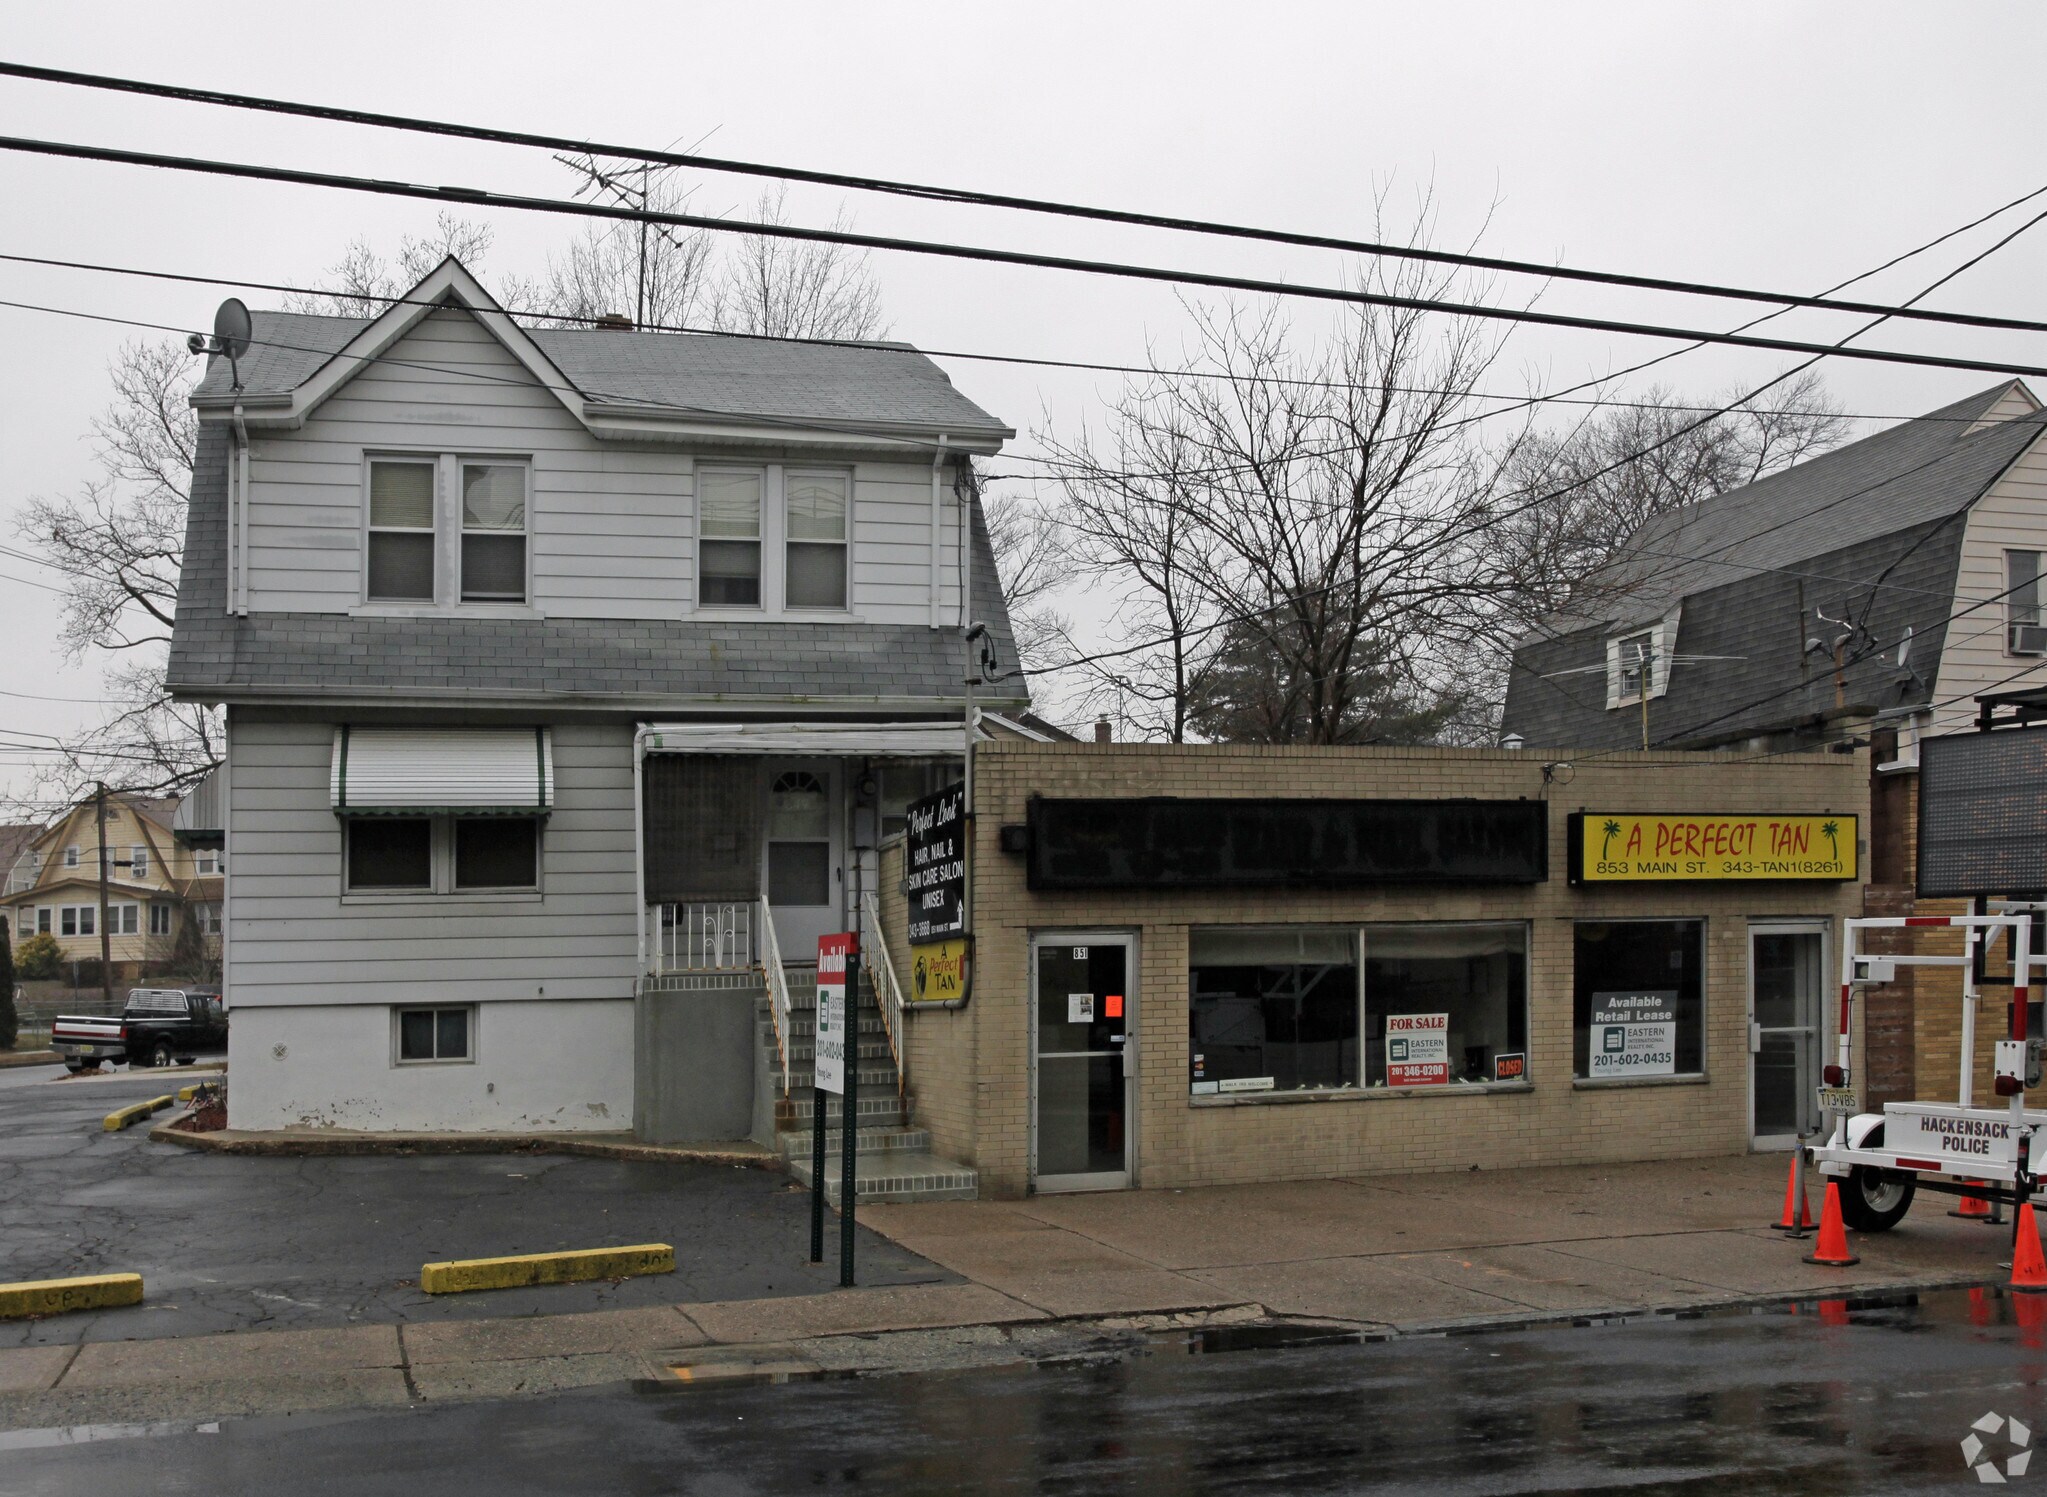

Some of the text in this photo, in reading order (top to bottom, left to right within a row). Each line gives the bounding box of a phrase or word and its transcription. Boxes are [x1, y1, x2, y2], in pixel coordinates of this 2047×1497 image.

[1626, 822, 1810, 858] A PERFECT TAN
[931, 842, 946, 860] NAIL
[948, 838, 954, 856] &
[909, 861, 964, 890] SKIN CARE SALON
[1596, 861, 1843, 874] 853 MAIN ST. 343-TAN1(8261)
[922, 889, 944, 909] UNISEX
[818, 945, 847, 973] Availabl
[941, 944, 947, 959] A
[929, 957, 958, 975] Perfect
[935, 973, 956, 991] TAN
[1608, 996, 1662, 1008] Available
[1390, 1017, 1445, 1030] FOR SALE
[1595, 1011, 1672, 1022] Retail Lease
[1628, 1028, 1664, 1037] EASTERN
[1498, 1059, 1523, 1076] CLOSED
[1594, 1053, 1672, 1066] 201-602-0435
[1392, 1065, 1443, 1076] 201 346-0200
[1921, 1117, 2010, 1139] HACKENSACK
[1942, 1136, 1990, 1155] POLICE
